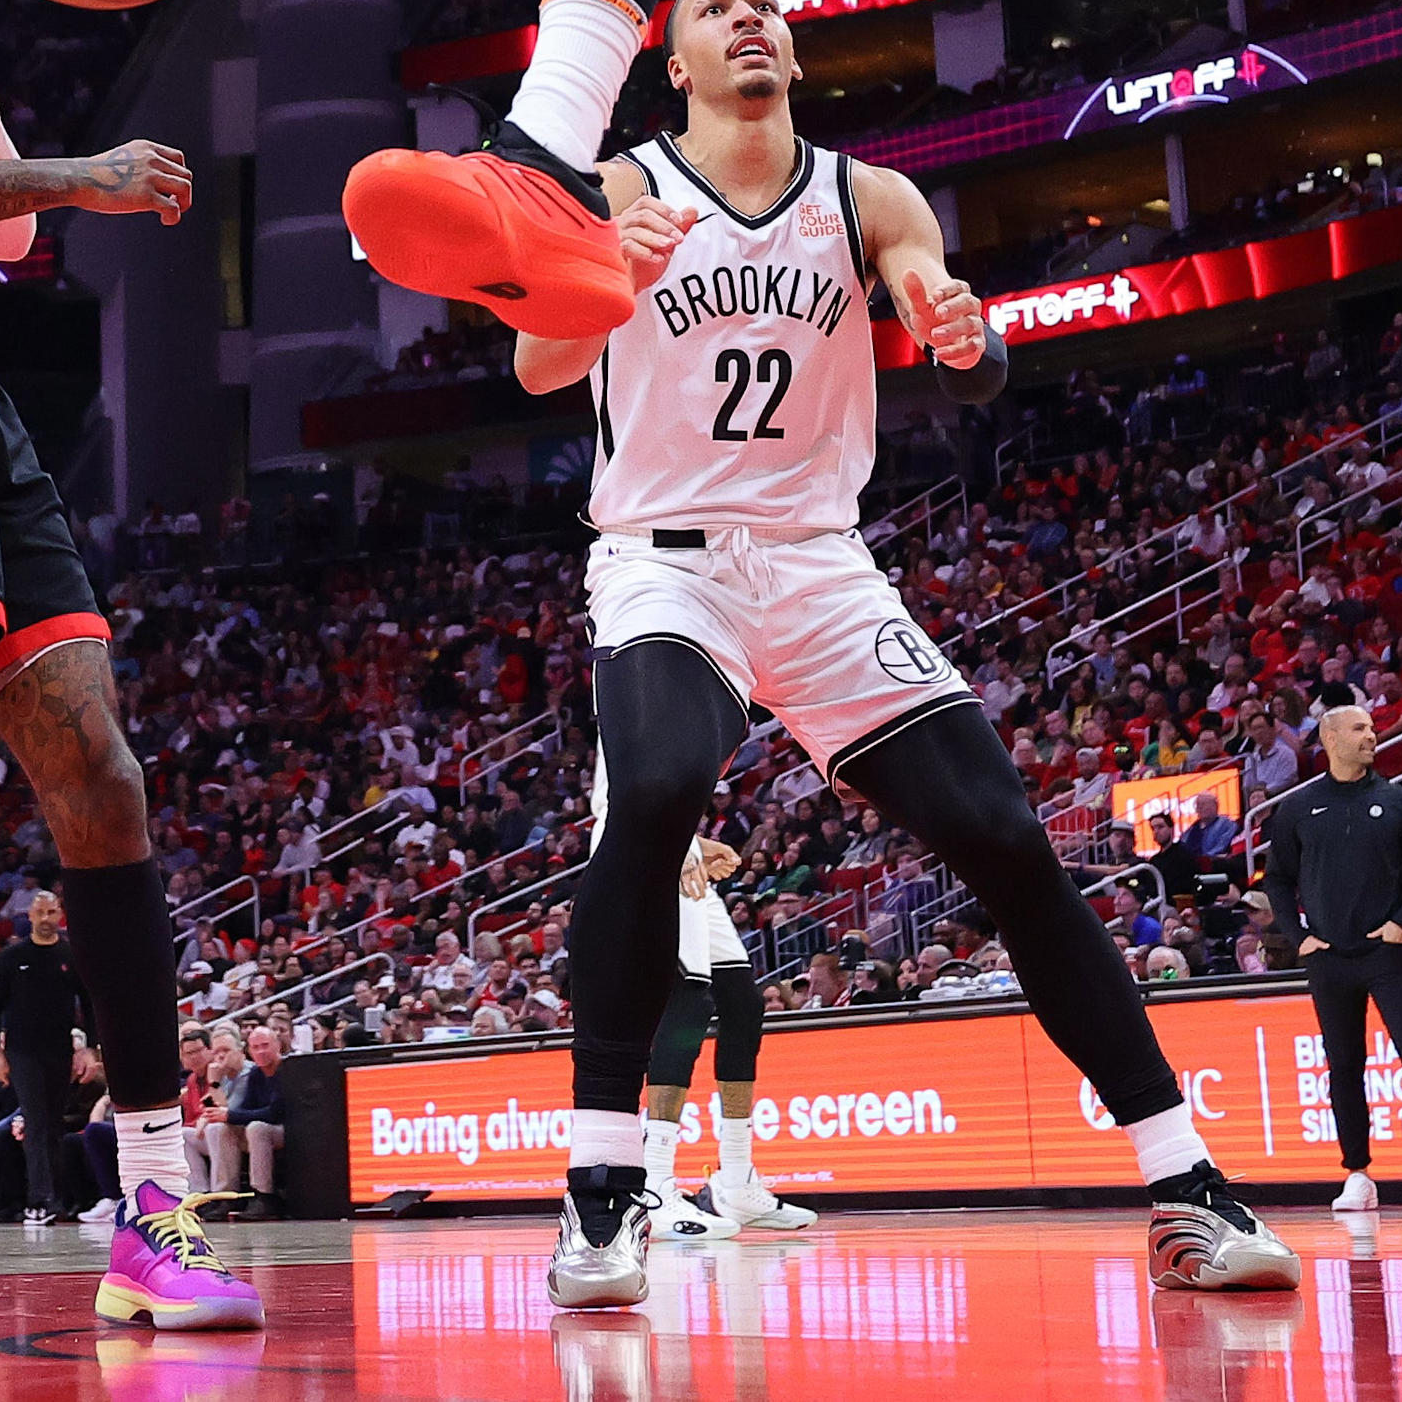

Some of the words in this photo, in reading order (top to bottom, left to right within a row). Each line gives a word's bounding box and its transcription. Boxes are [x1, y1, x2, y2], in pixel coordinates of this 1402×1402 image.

[1106, 57, 1235, 116] LIFTOFF
[798, 202, 822, 216] GET
[798, 223, 846, 238] GUIDE
[799, 212, 840, 228] YOUR
[654, 265, 852, 338] BROOKLYN
[712, 348, 793, 442] 22
[371, 1101, 479, 1166] Boring
[788, 1088, 958, 1140] screen.
